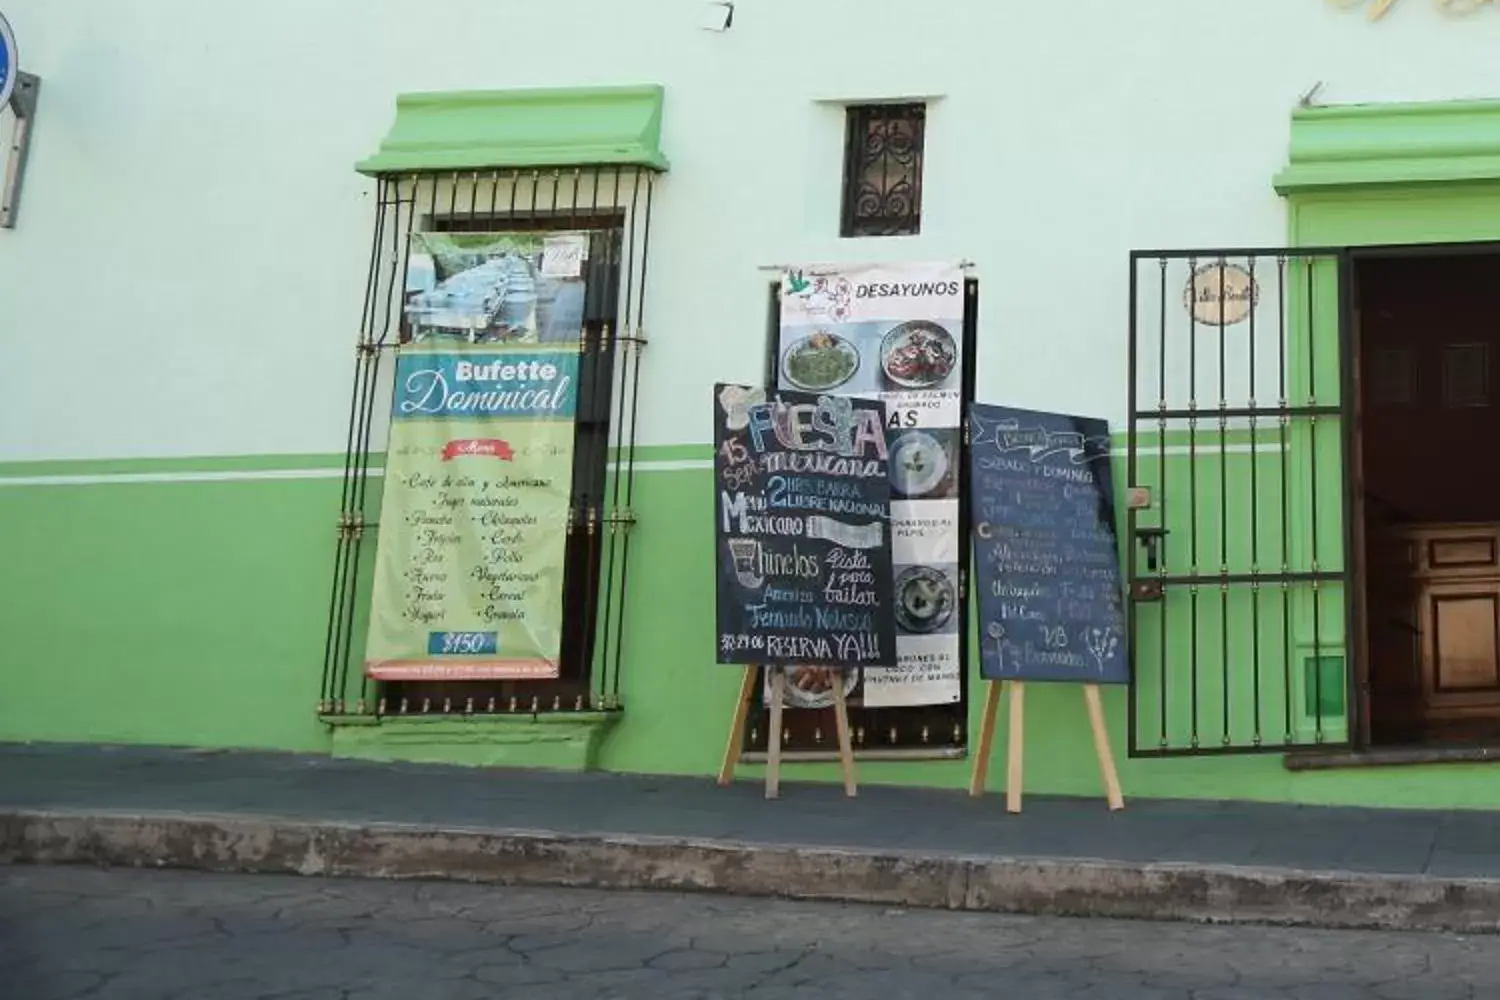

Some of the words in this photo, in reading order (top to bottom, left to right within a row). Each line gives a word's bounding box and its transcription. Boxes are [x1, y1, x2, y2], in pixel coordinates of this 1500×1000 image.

[855, 281, 960, 299] DESAYUNOS
[455, 361, 558, 382] Bufette
[401, 367, 572, 413] Dominical
[750, 396, 890, 462] FIESTA
[888, 410, 918, 428] AS
[764, 451, 888, 477] mexicana
[767, 475, 786, 509] 2
[441, 633, 486, 655] $150
[766, 635, 833, 659] RESERVA
